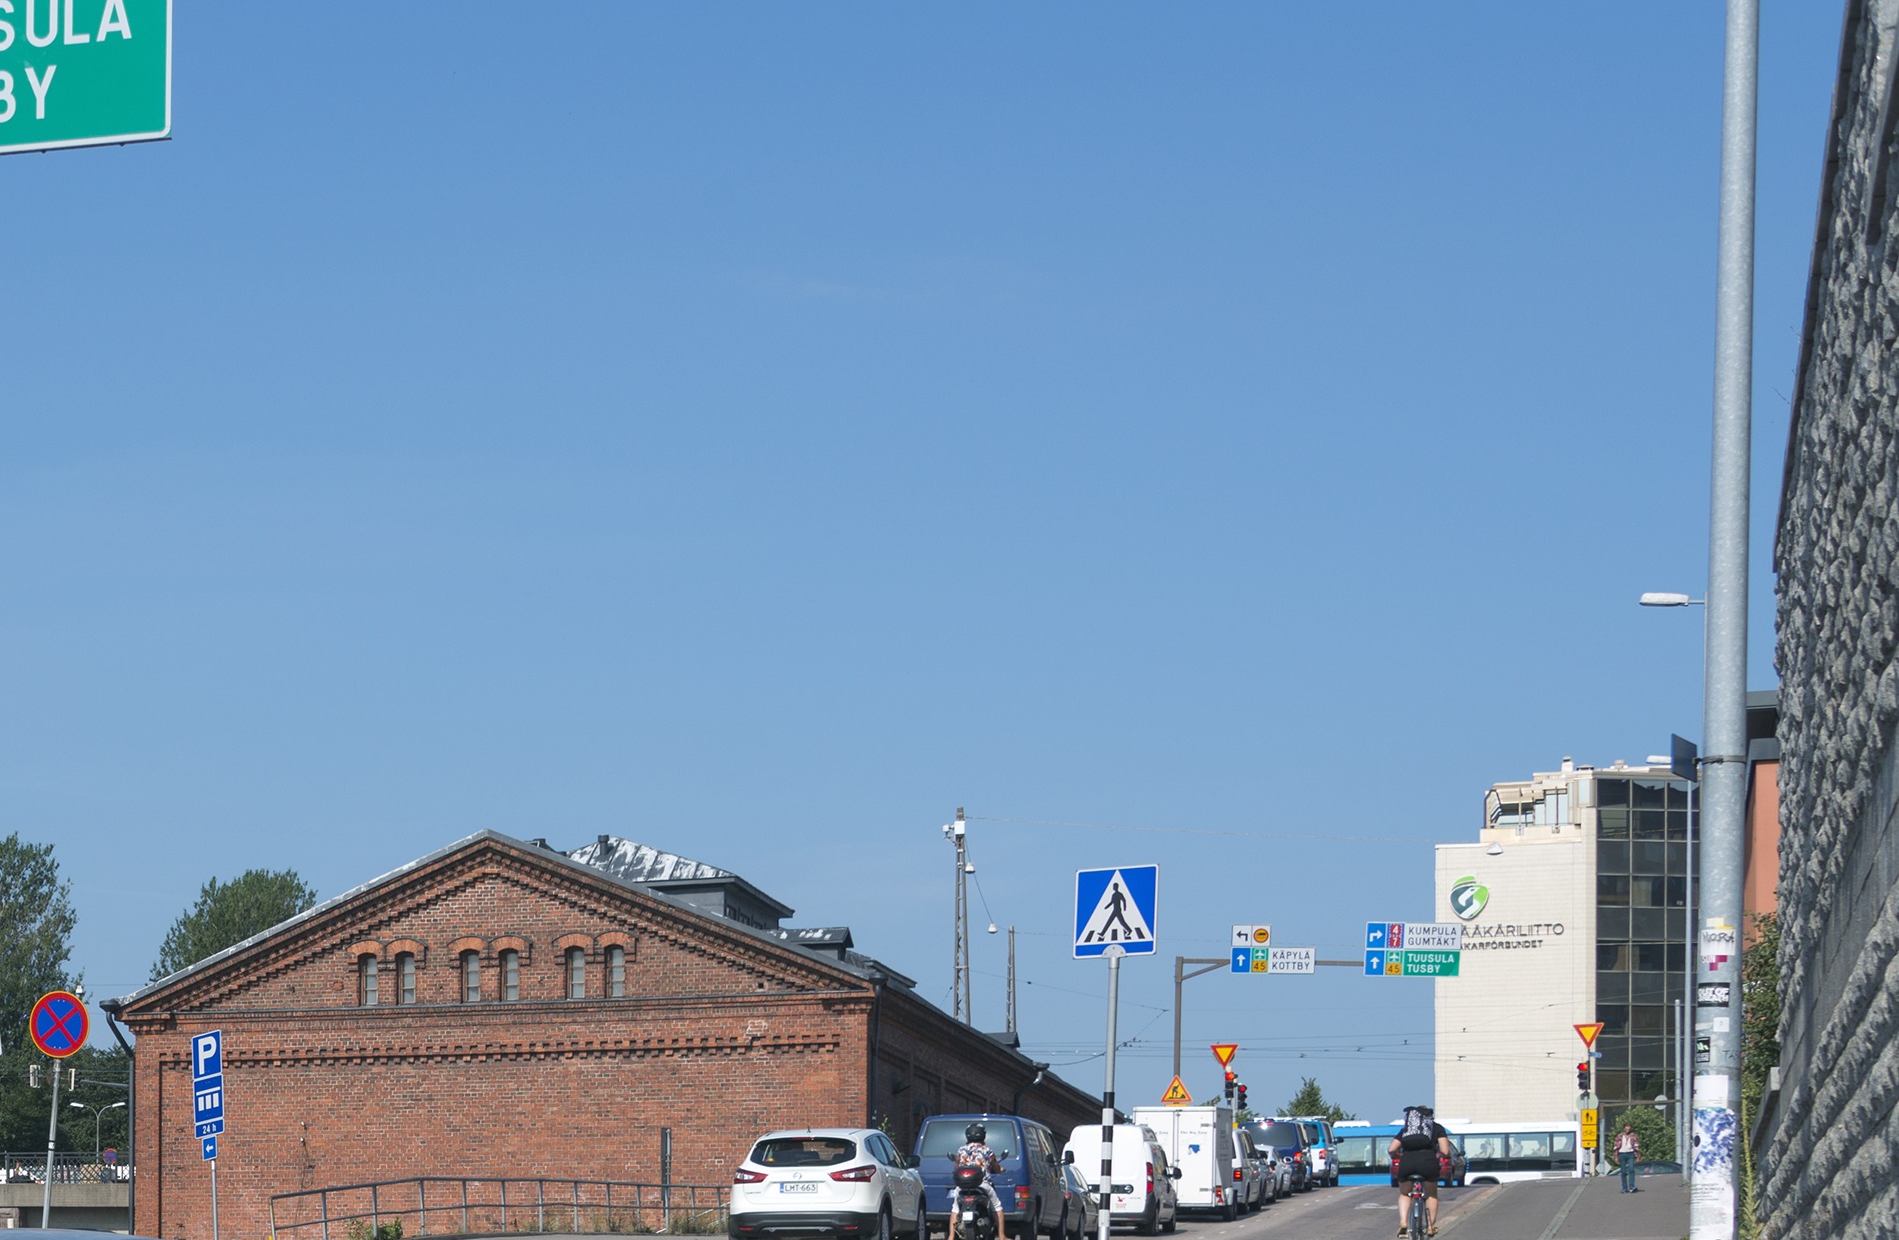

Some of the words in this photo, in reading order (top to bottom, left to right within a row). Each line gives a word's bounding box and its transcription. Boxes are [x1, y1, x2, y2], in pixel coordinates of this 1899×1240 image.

[1408, 926, 1457, 936] KUMPULA
[1407, 936, 1457, 946] GUMTÄKT
[1272, 949, 1311, 960] KÄPYLÄ
[1407, 953, 1454, 963] TUUSULA
[1253, 961, 1267, 971] 45
[1271, 961, 1310, 970] KOTTBY
[1387, 964, 1401, 973] 45
[1407, 964, 1441, 973] TUSBY
[197, 1035, 217, 1076] P
[202, 1123, 211, 1135] 24
[784, 1183, 817, 1192] LMT-663
